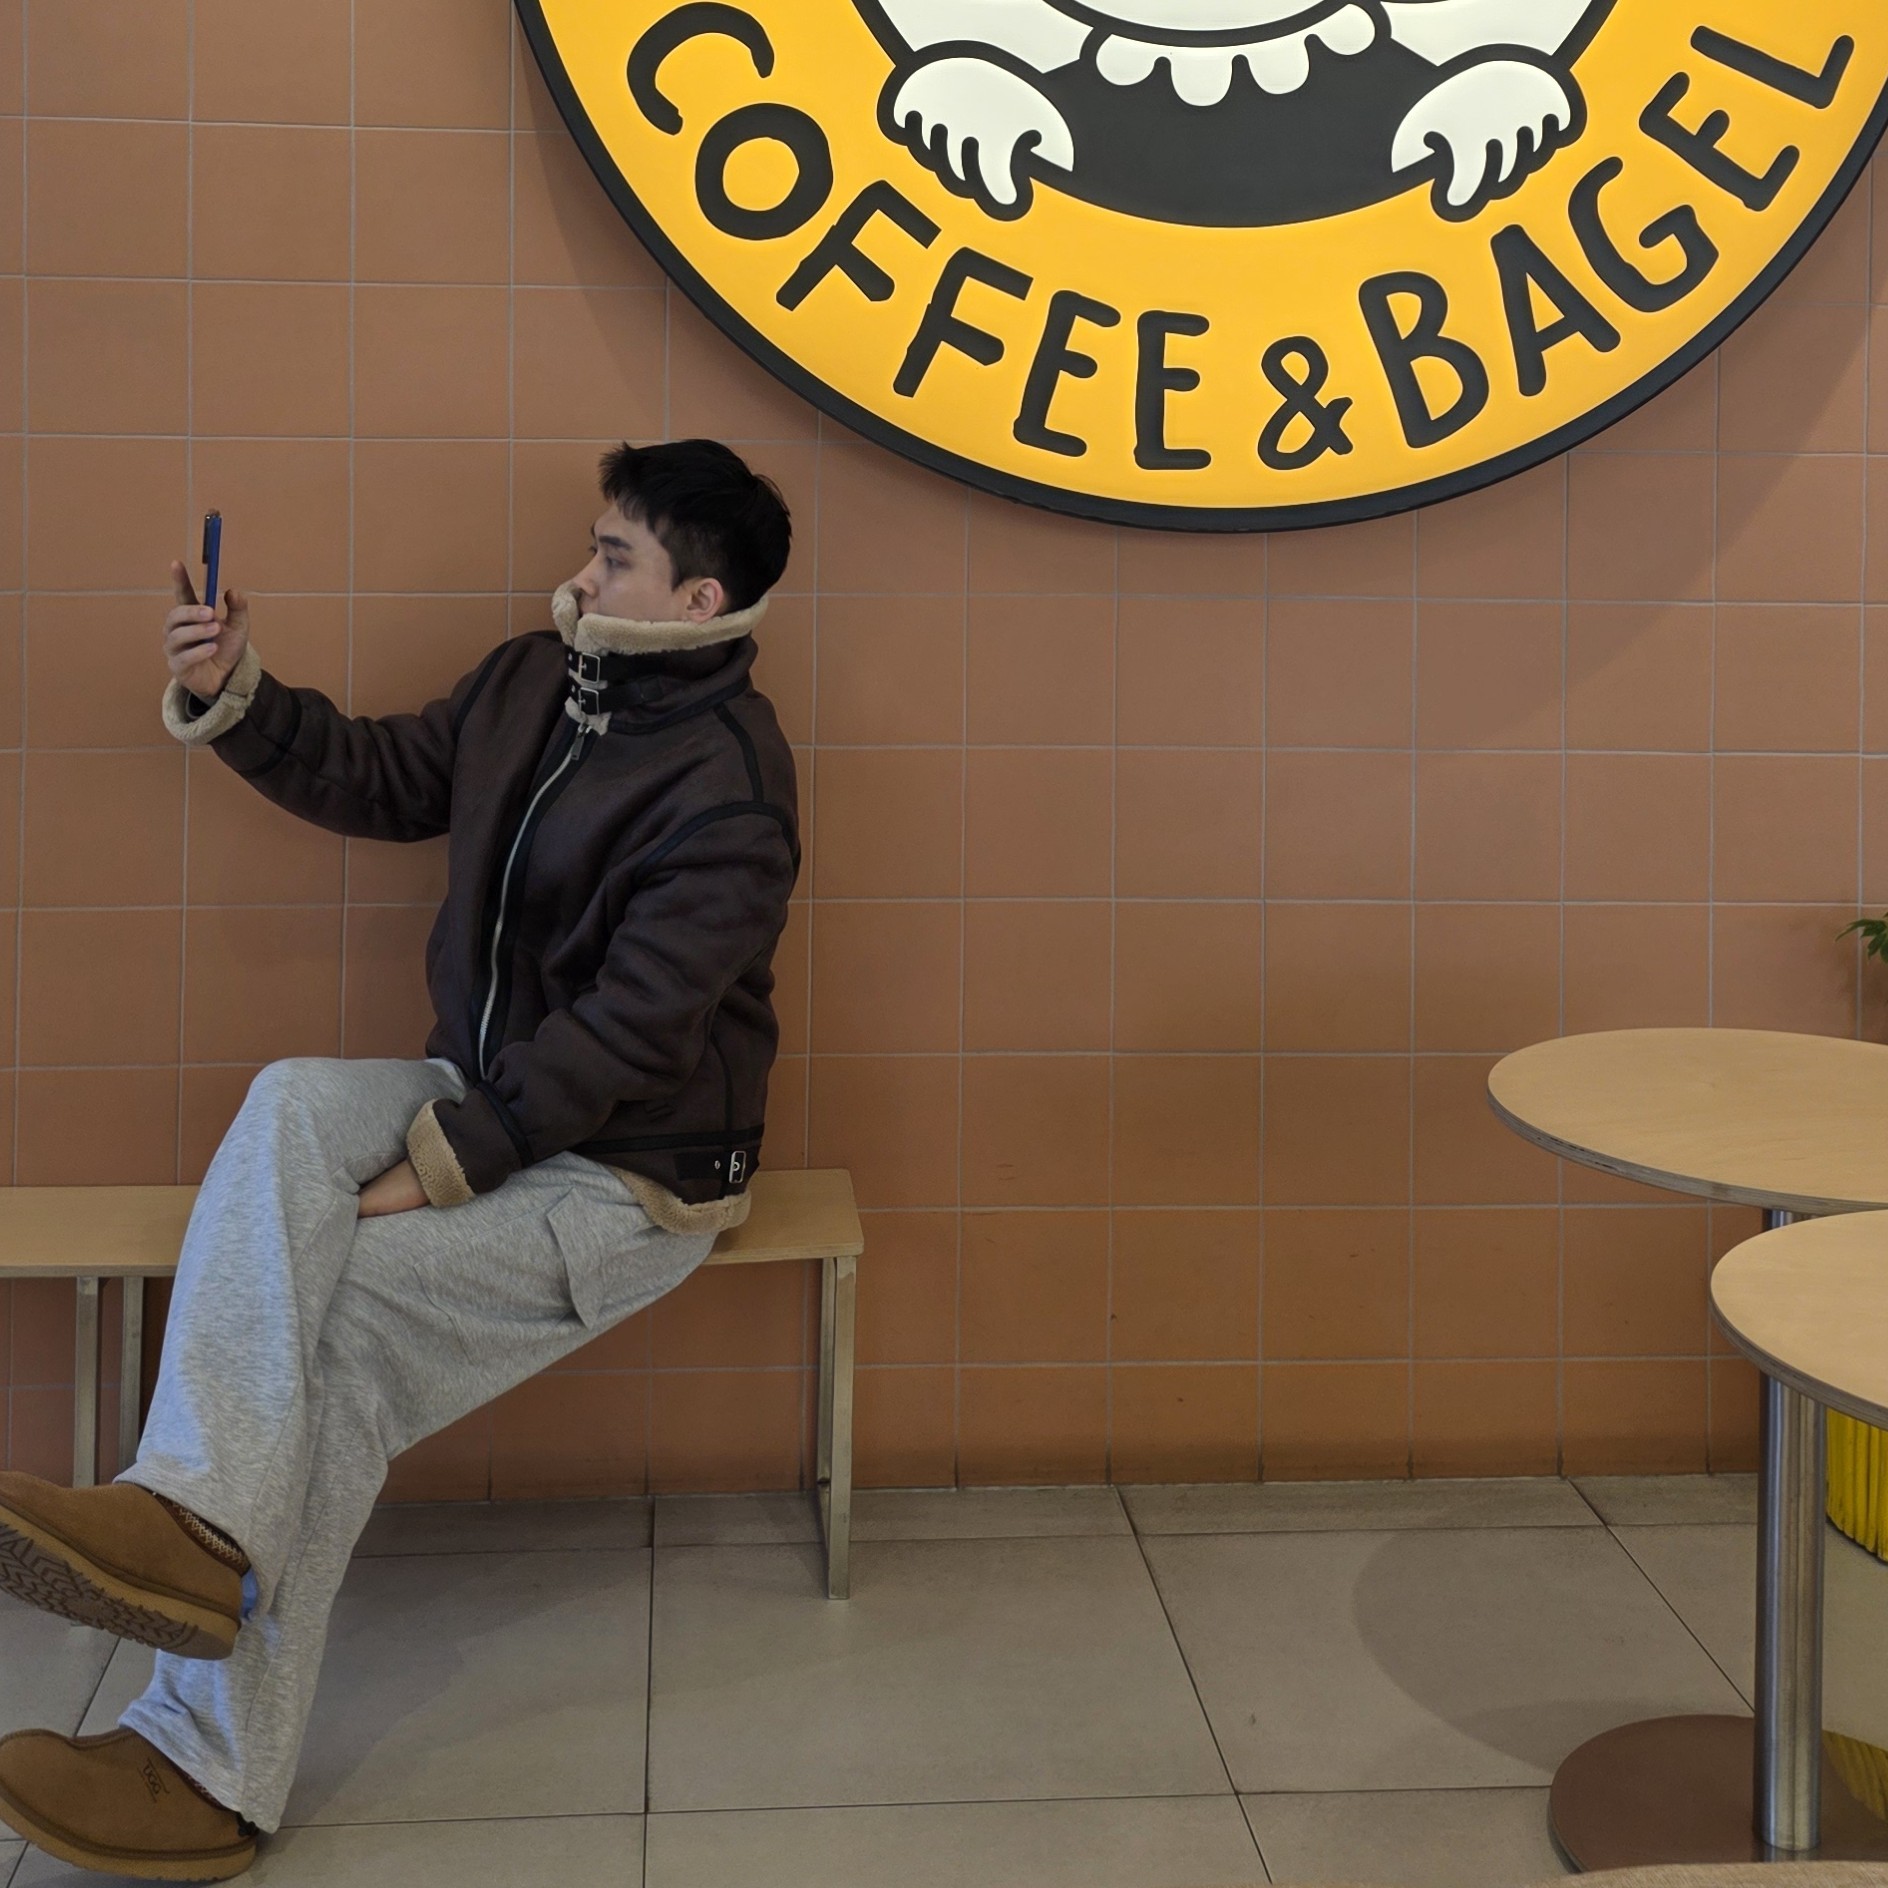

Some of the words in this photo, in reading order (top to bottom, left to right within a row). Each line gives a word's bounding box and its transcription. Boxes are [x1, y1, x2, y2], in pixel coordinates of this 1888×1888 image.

[626, 2, 1212, 471] COFFEE
[1257, 335, 1354, 471] &
[1358, 25, 1855, 449] BAGEL
